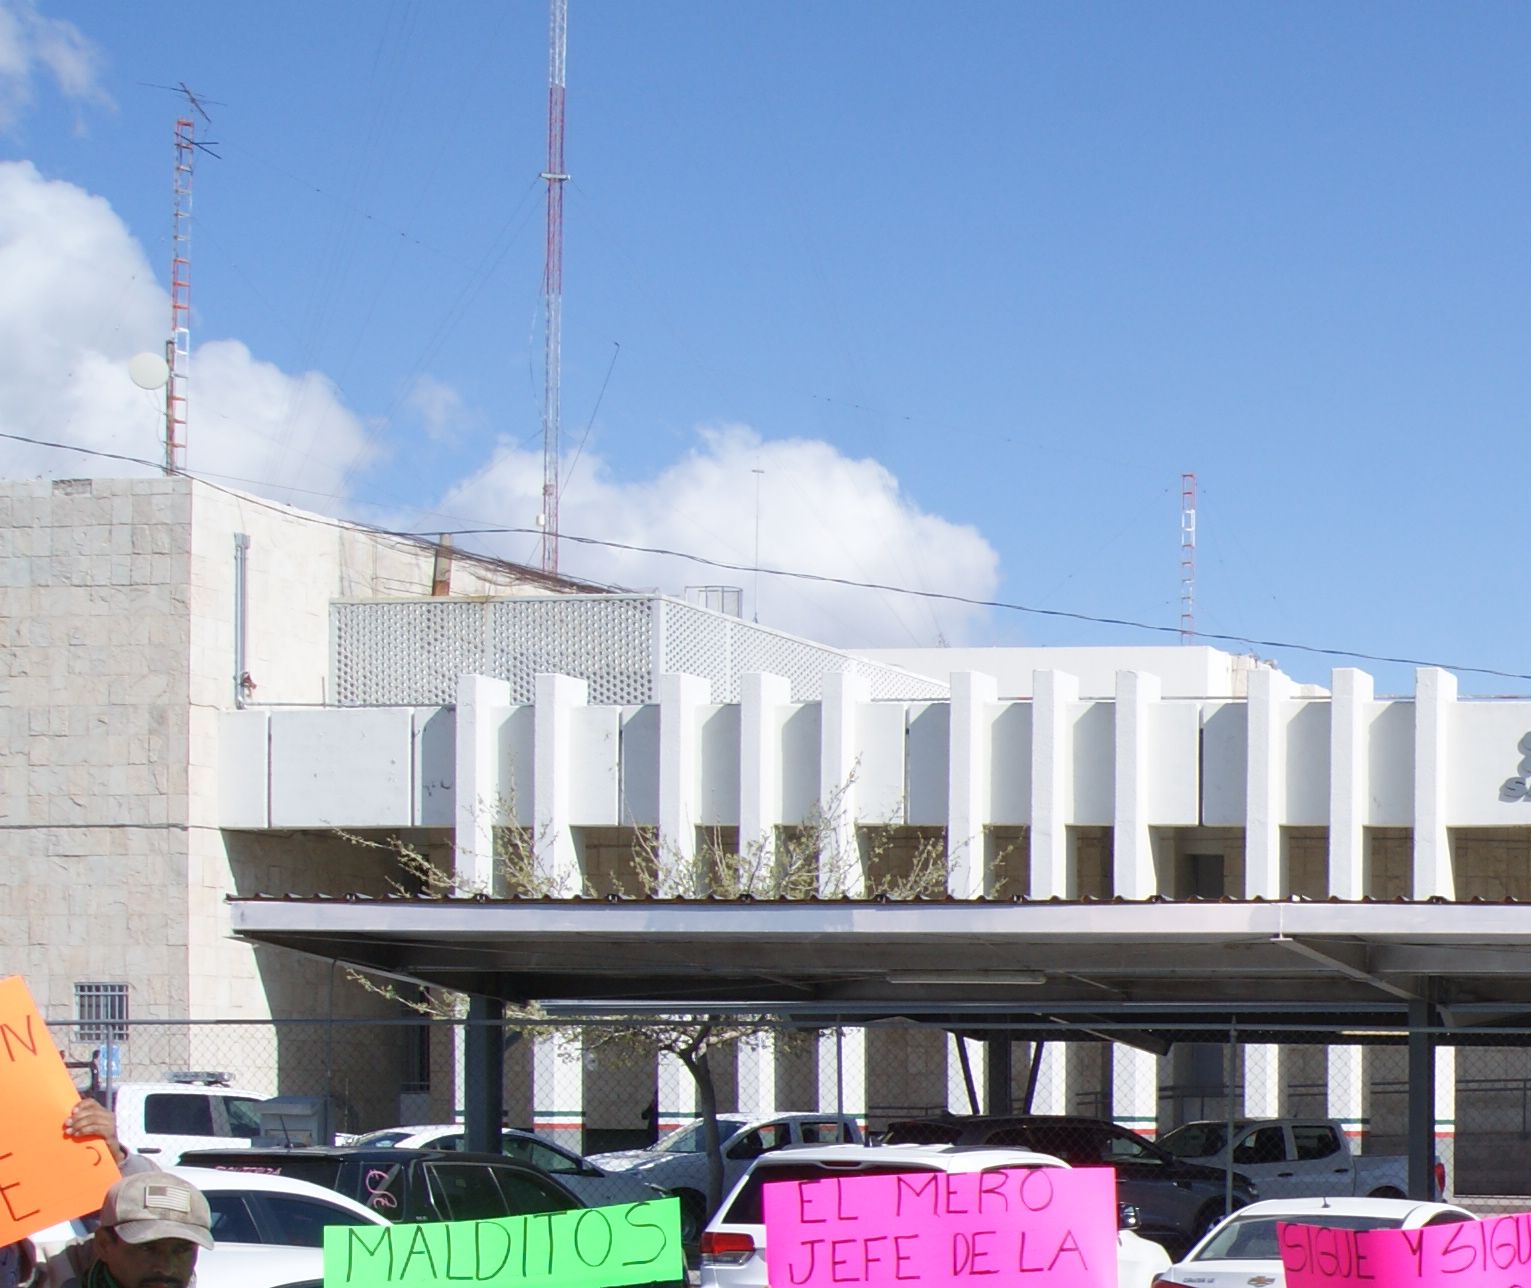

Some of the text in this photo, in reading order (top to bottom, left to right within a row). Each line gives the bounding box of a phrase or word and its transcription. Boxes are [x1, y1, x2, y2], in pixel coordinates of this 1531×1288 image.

[798, 1169, 1054, 1224] EL MERO
[346, 1202, 667, 1283] MALDITOS
[788, 1229, 1089, 1285] JEFE DE LA
[1282, 1222, 1376, 1280] SIGUE
[1401, 1229, 1424, 1278] Y
